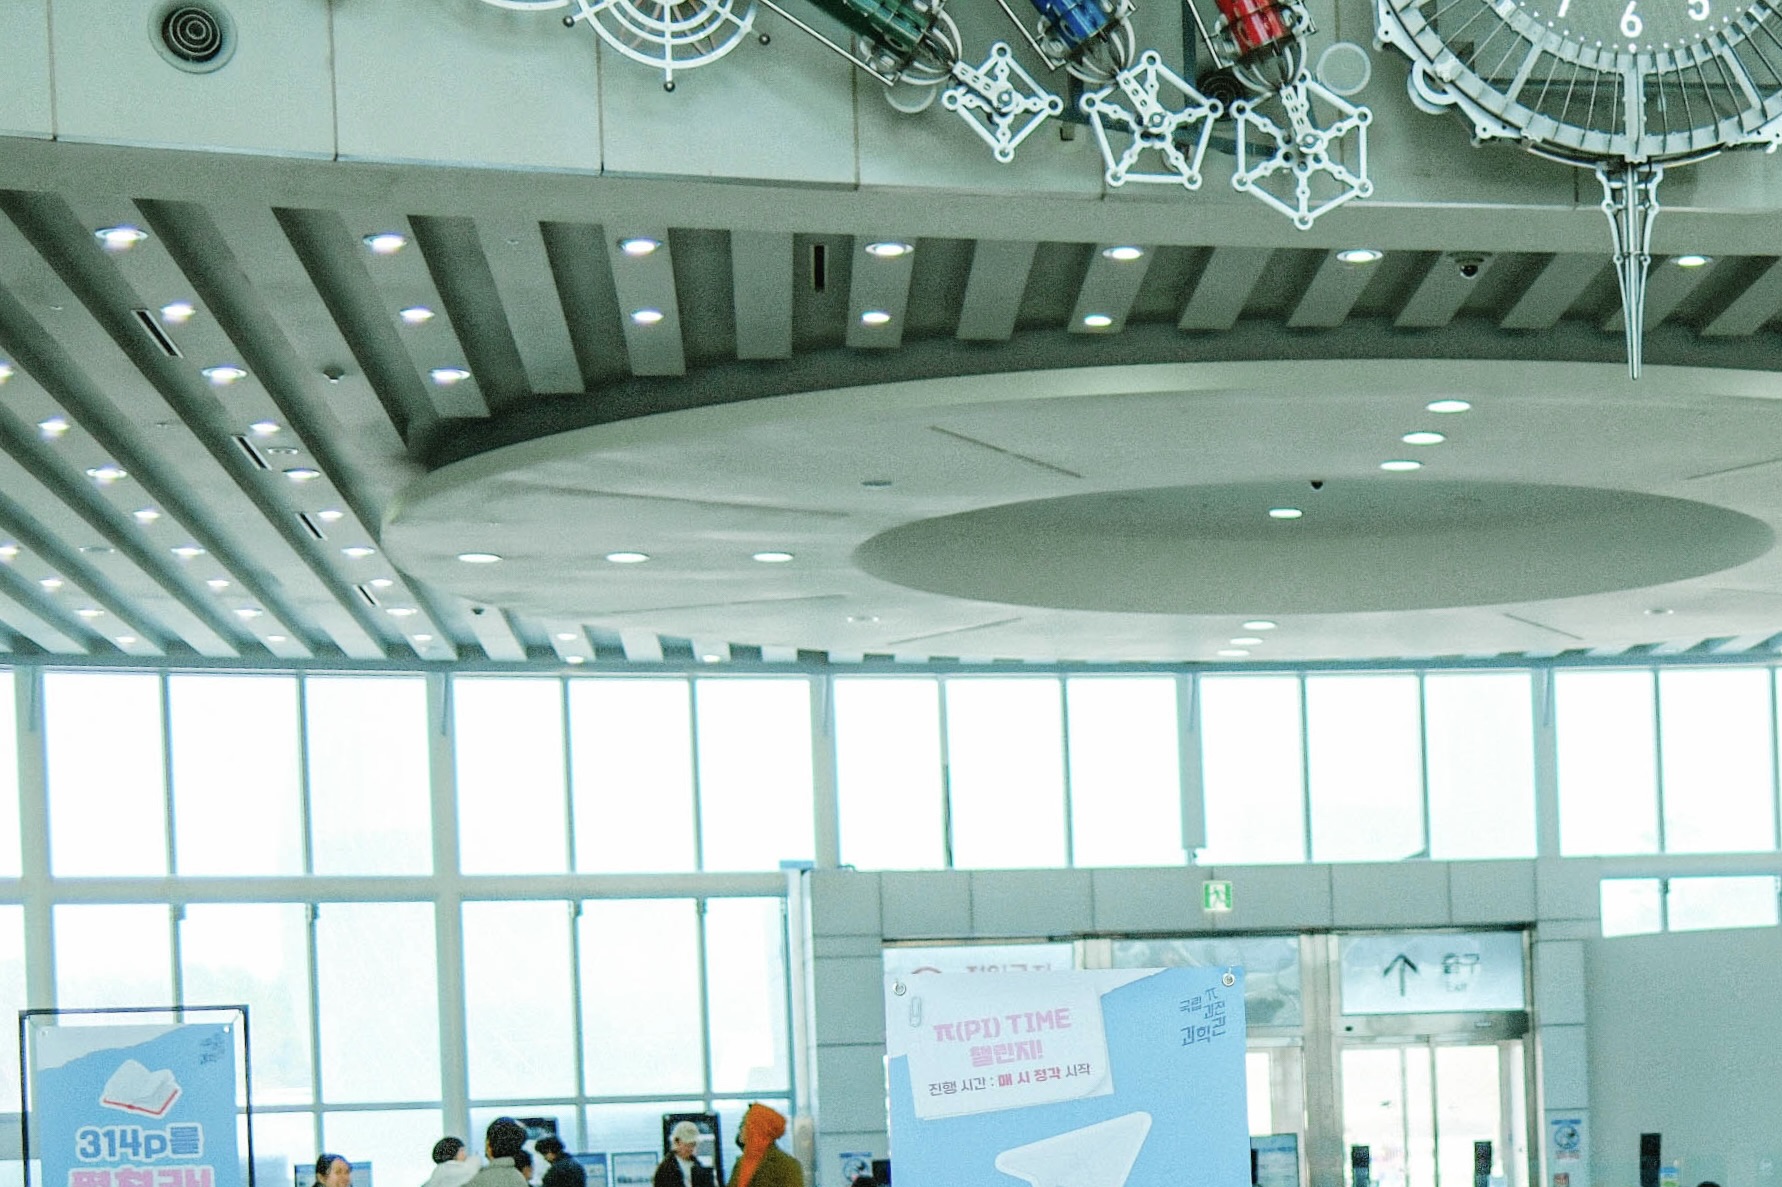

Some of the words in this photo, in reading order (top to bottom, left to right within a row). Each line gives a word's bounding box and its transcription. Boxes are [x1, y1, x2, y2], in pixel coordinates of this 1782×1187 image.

[1620, 1, 1643, 38] 6
[1005, 1008, 1072, 1035] TIME
[969, 1039, 1044, 1068] 챌린지!
[928, 1081, 957, 1097] 진행
[960, 1077, 987, 1092] 시간
[997, 1073, 1013, 1088] 매
[1016, 1070, 1030, 1085] 시
[1033, 1066, 1062, 1082] 정각
[1065, 1063, 1091, 1078] 시작
[78, 1126, 200, 1160] 314p를
